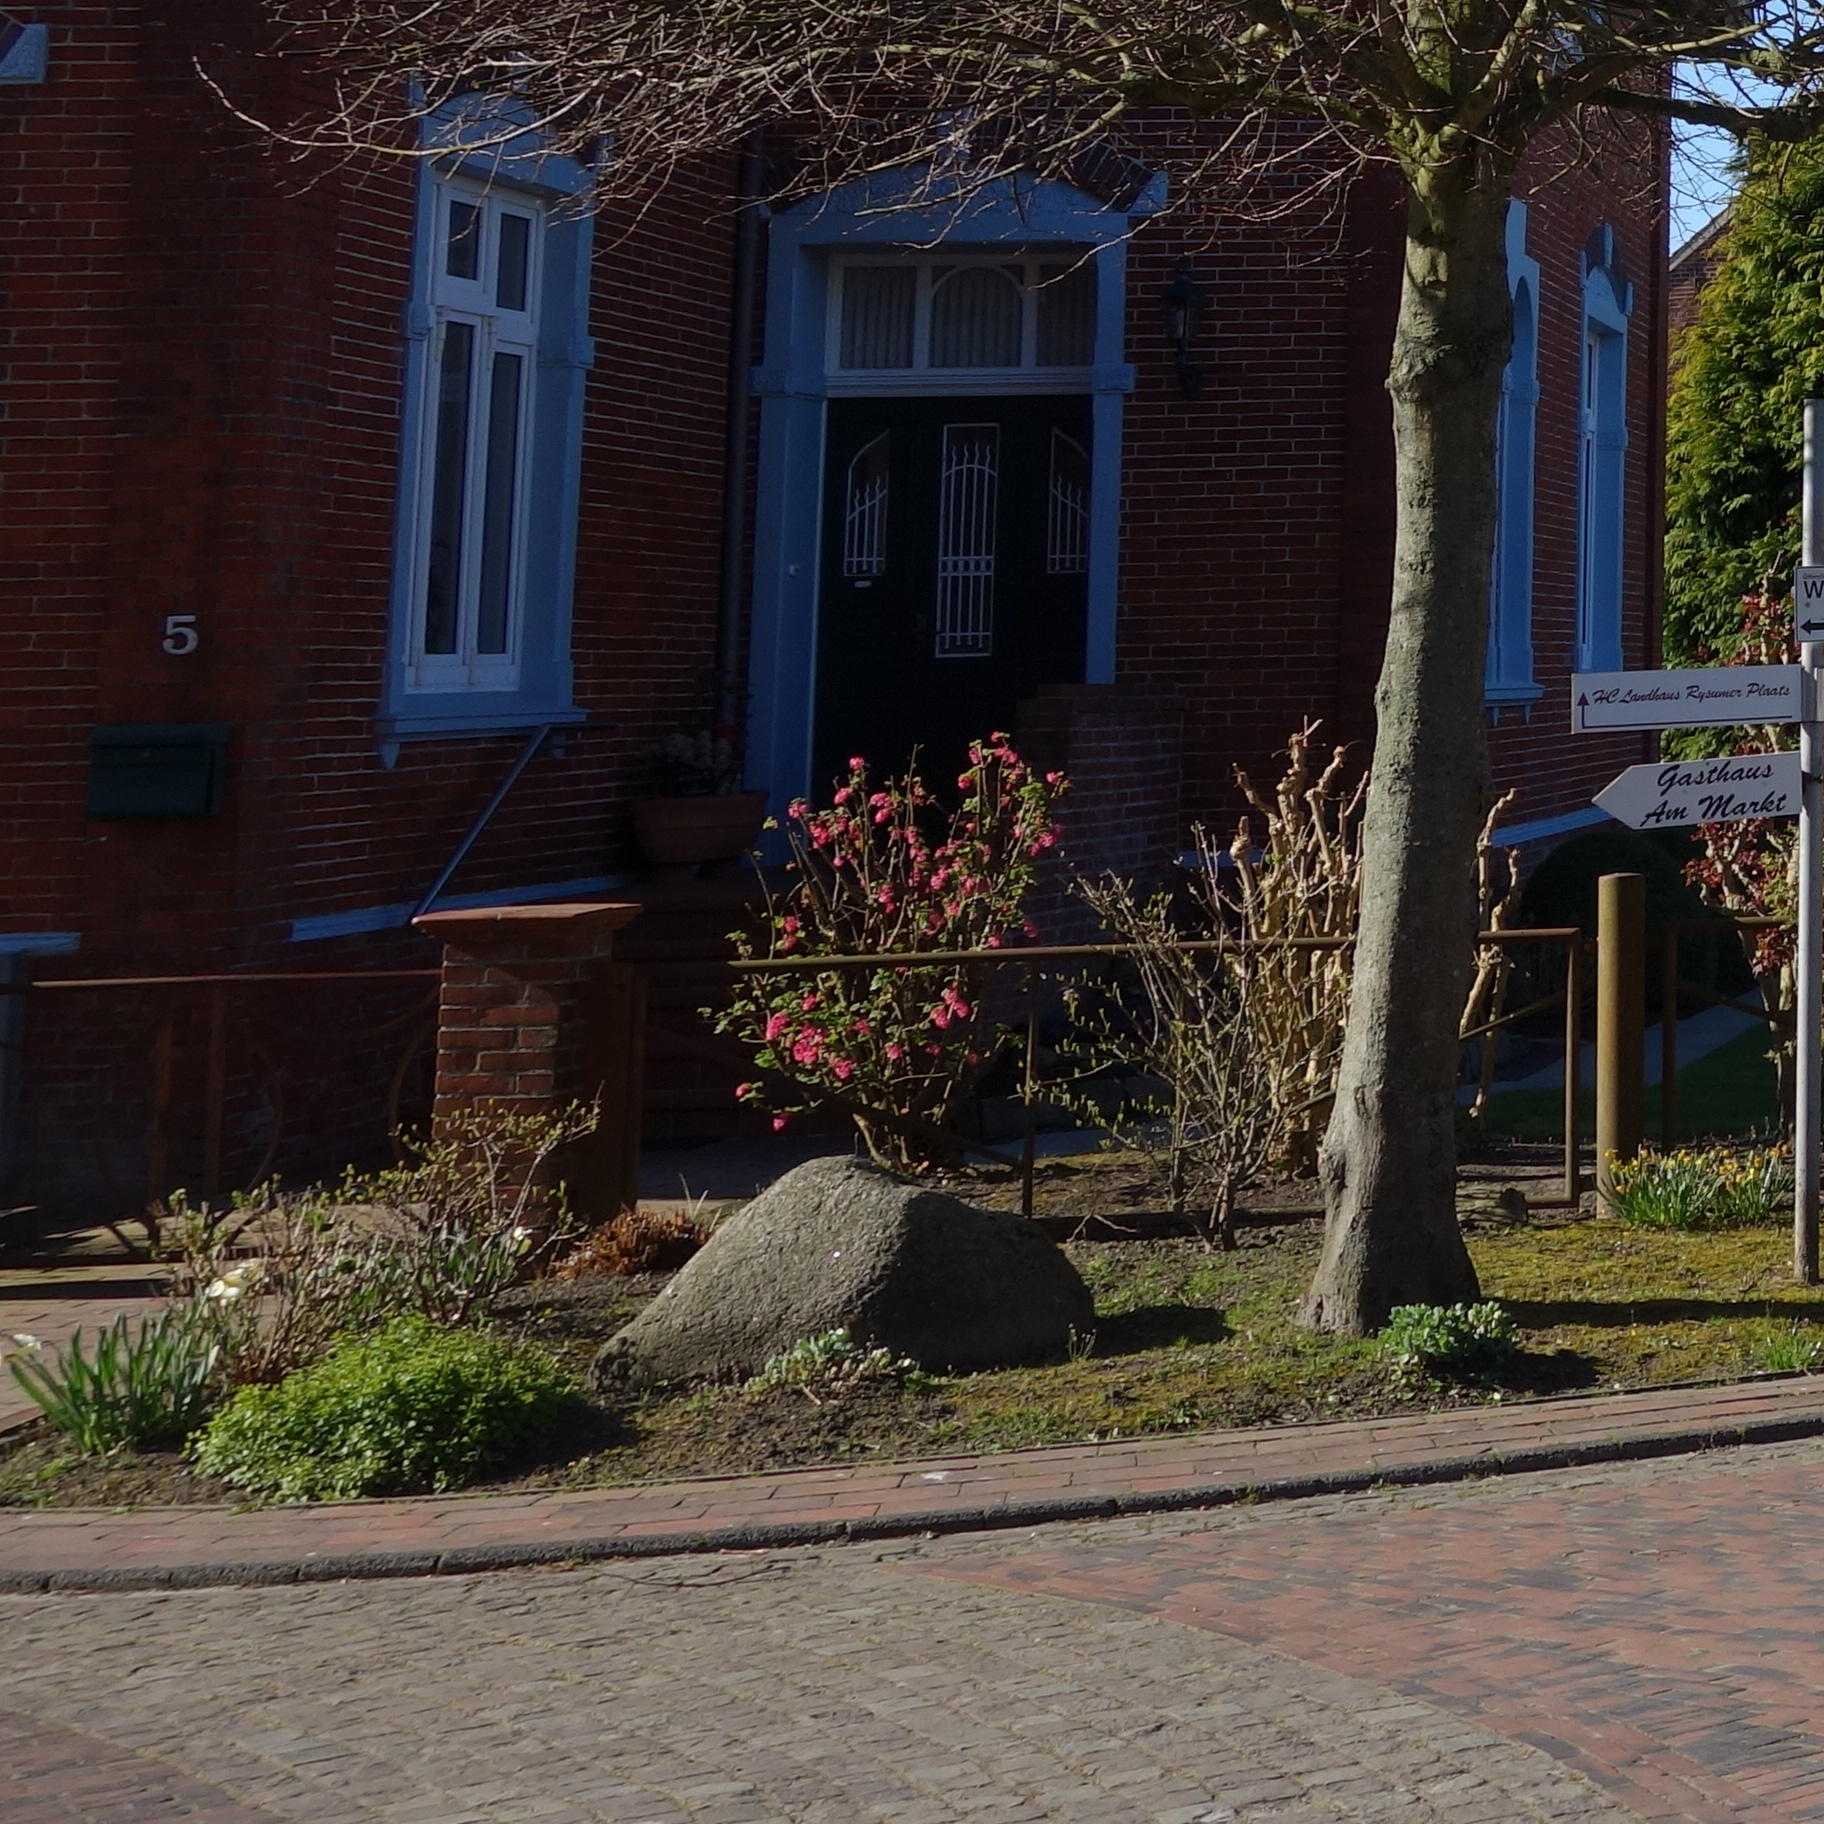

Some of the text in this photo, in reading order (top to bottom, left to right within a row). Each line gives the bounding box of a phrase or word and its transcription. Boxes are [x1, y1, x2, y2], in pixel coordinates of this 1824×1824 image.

[162, 614, 199, 655] 5
[1619, 687, 1680, 704] Landhaus
[1685, 684, 1742, 703] Rysumer
[1745, 682, 1790, 698] Plaats
[1657, 760, 1774, 797] Gasthaus
[1640, 790, 1787, 826] Am Markt
